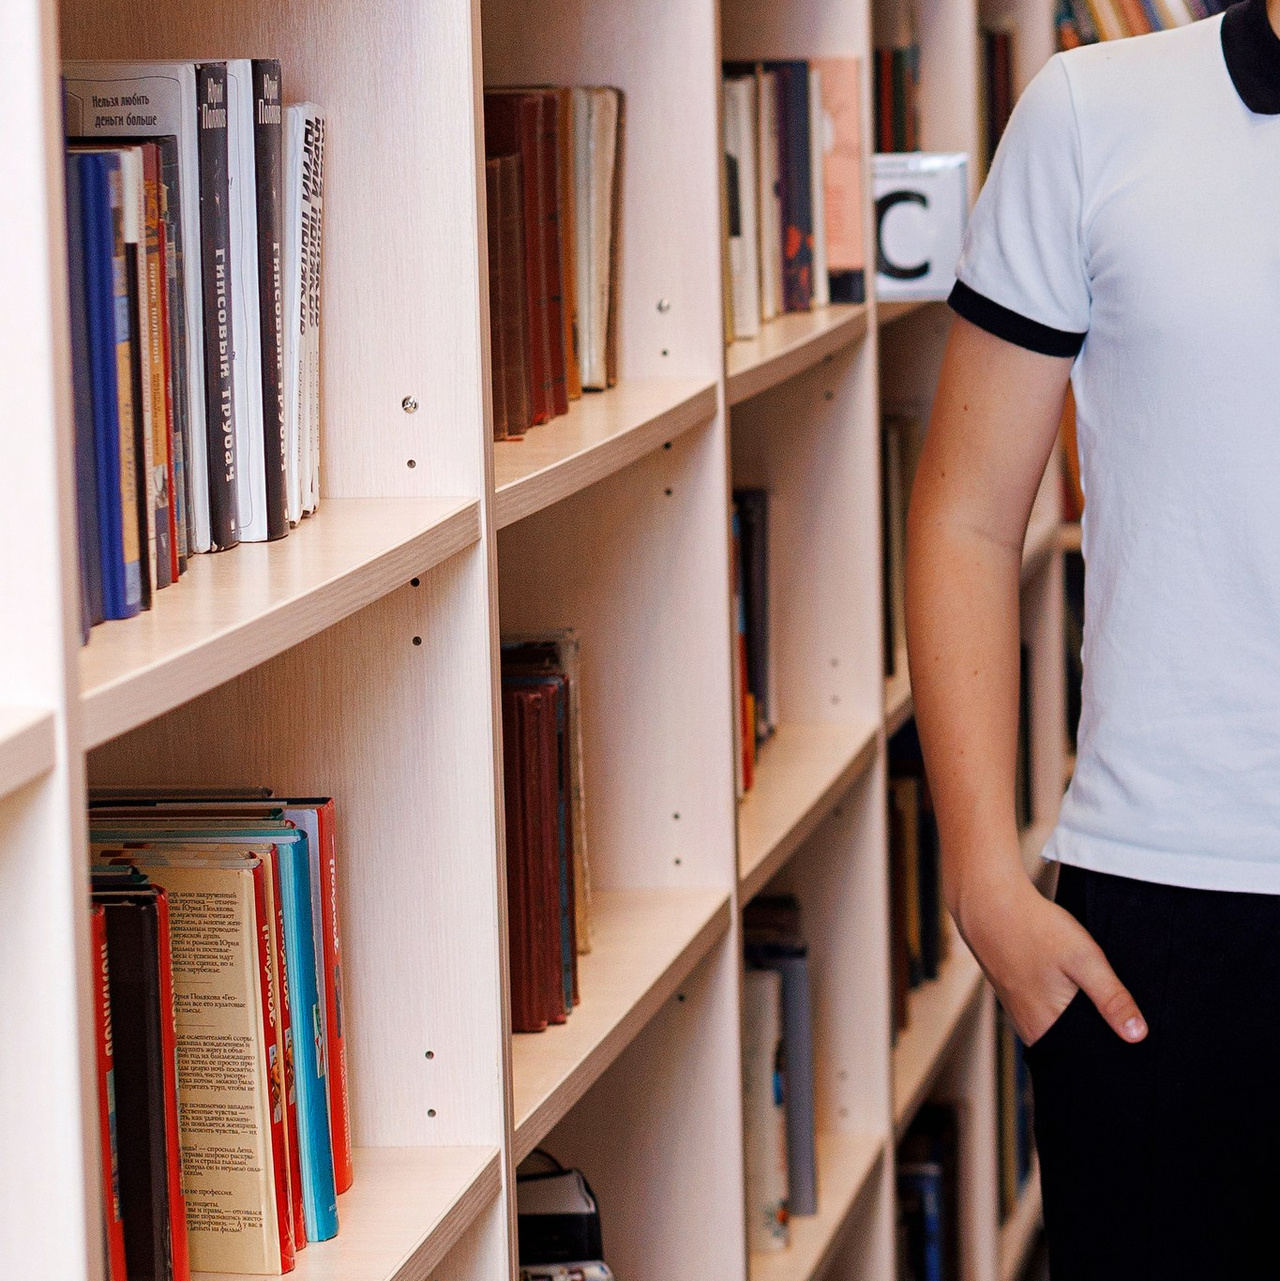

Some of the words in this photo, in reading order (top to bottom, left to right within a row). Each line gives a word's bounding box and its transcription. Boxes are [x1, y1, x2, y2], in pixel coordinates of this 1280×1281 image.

[92, 95, 119, 106] Нельзя
[121, 94, 149, 106] любить
[95, 115, 124, 128] деньги
[126, 114, 157, 126] больше
[874, 190, 931, 281] С
